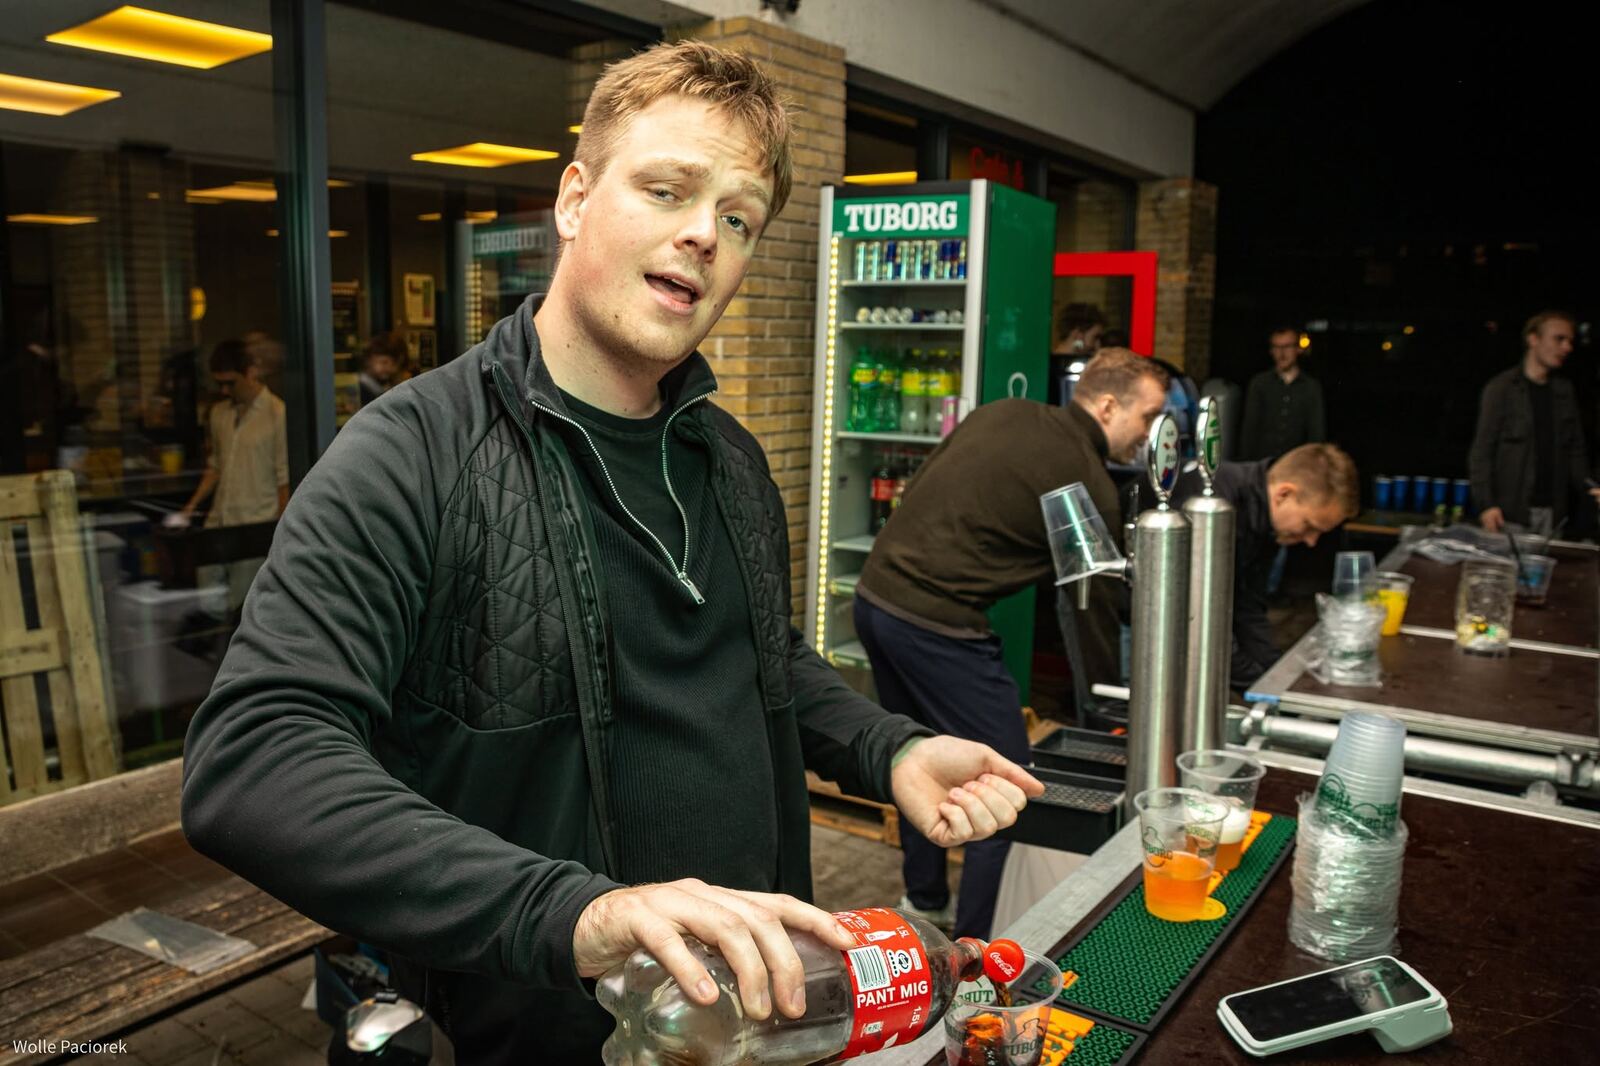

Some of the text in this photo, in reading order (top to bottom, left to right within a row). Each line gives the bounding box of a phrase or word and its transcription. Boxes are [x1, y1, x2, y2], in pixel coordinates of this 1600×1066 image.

[844, 200, 958, 232] TUBORG
[857, 987, 896, 1008] PANT
[901, 980, 929, 999] MIG
